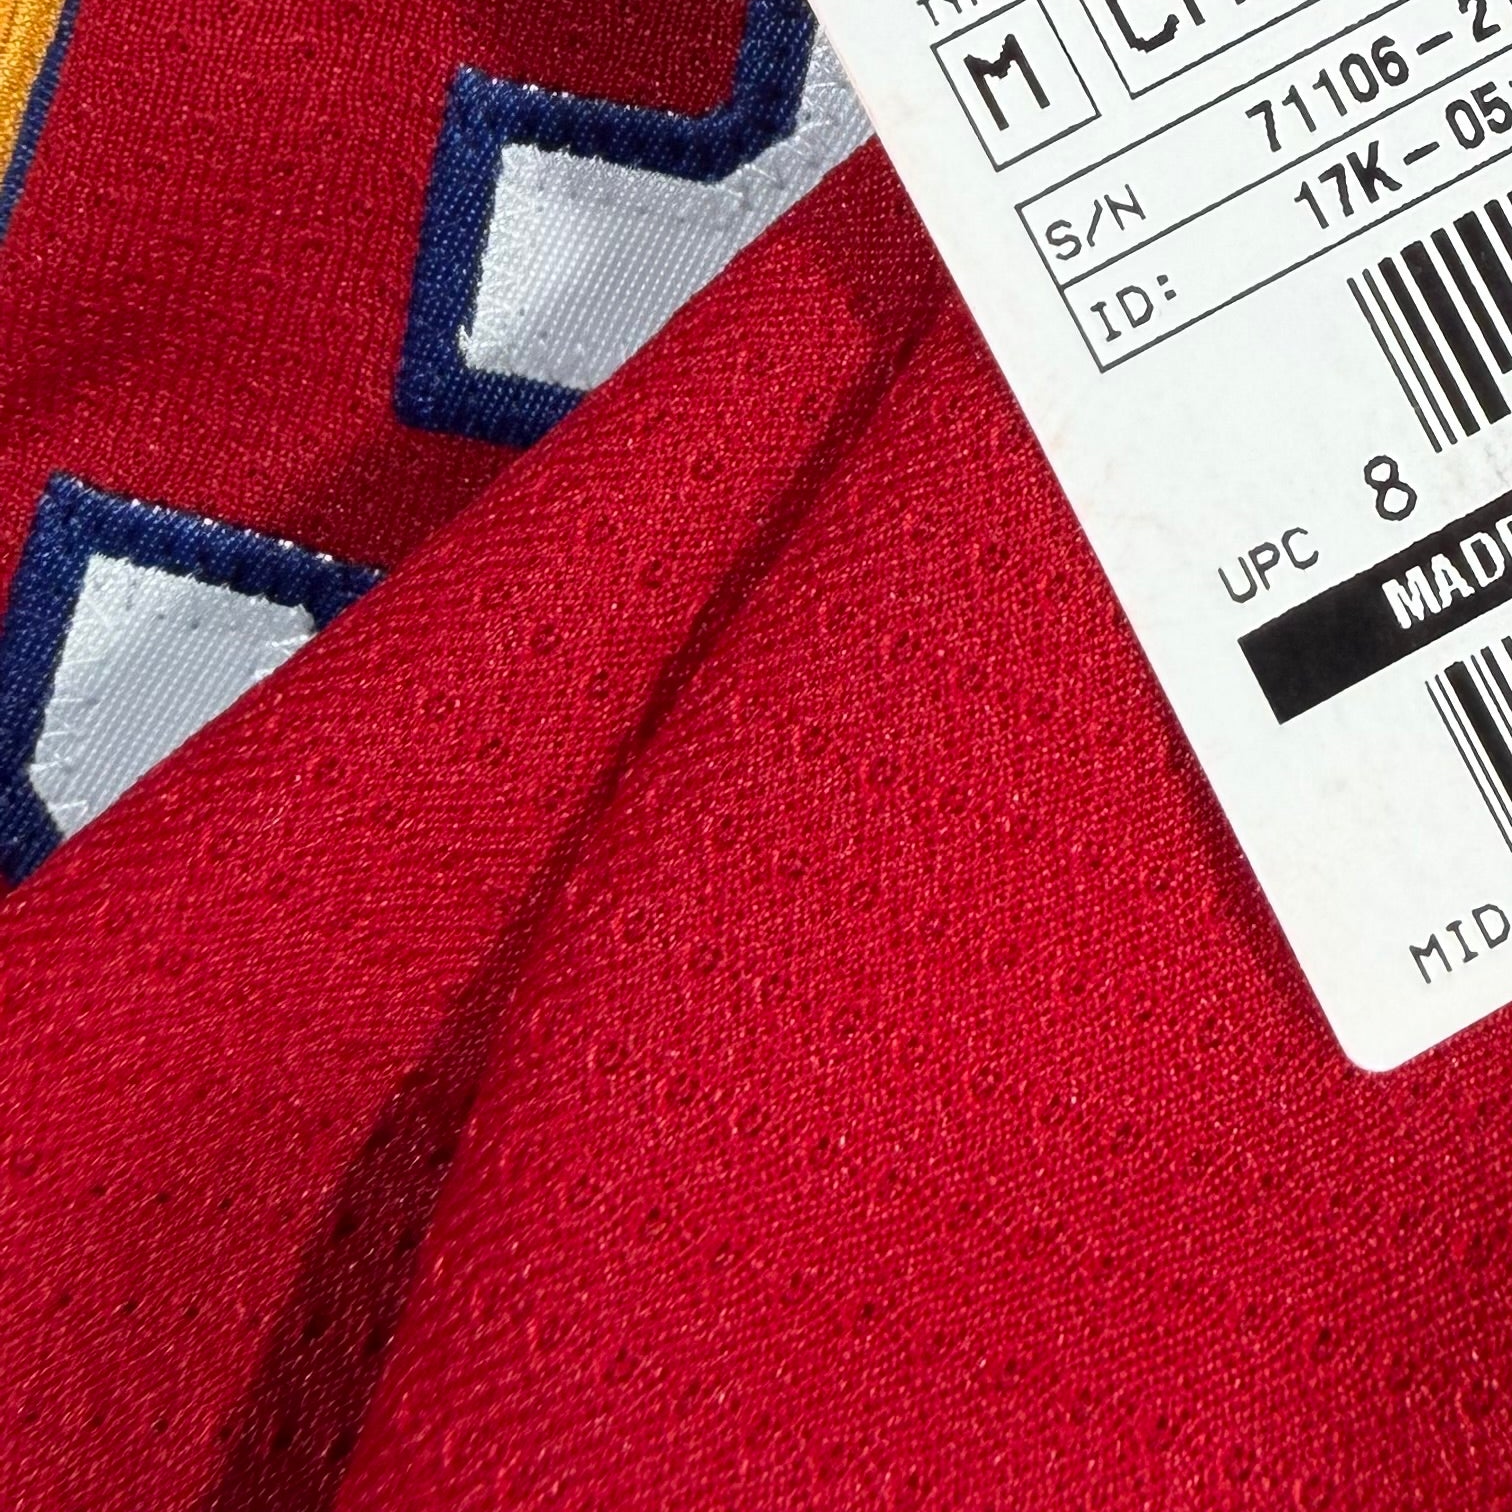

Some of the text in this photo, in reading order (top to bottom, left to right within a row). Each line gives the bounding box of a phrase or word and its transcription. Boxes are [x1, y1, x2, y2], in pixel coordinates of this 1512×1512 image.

[964, 33, 1050, 130] M
[1046, 184, 1146, 260] S/N
[1090, 275, 1176, 342] ID:
[1218, 527, 1319, 603] UPC
[1364, 455, 1417, 521] 8
[1409, 904, 1510, 983] MID
